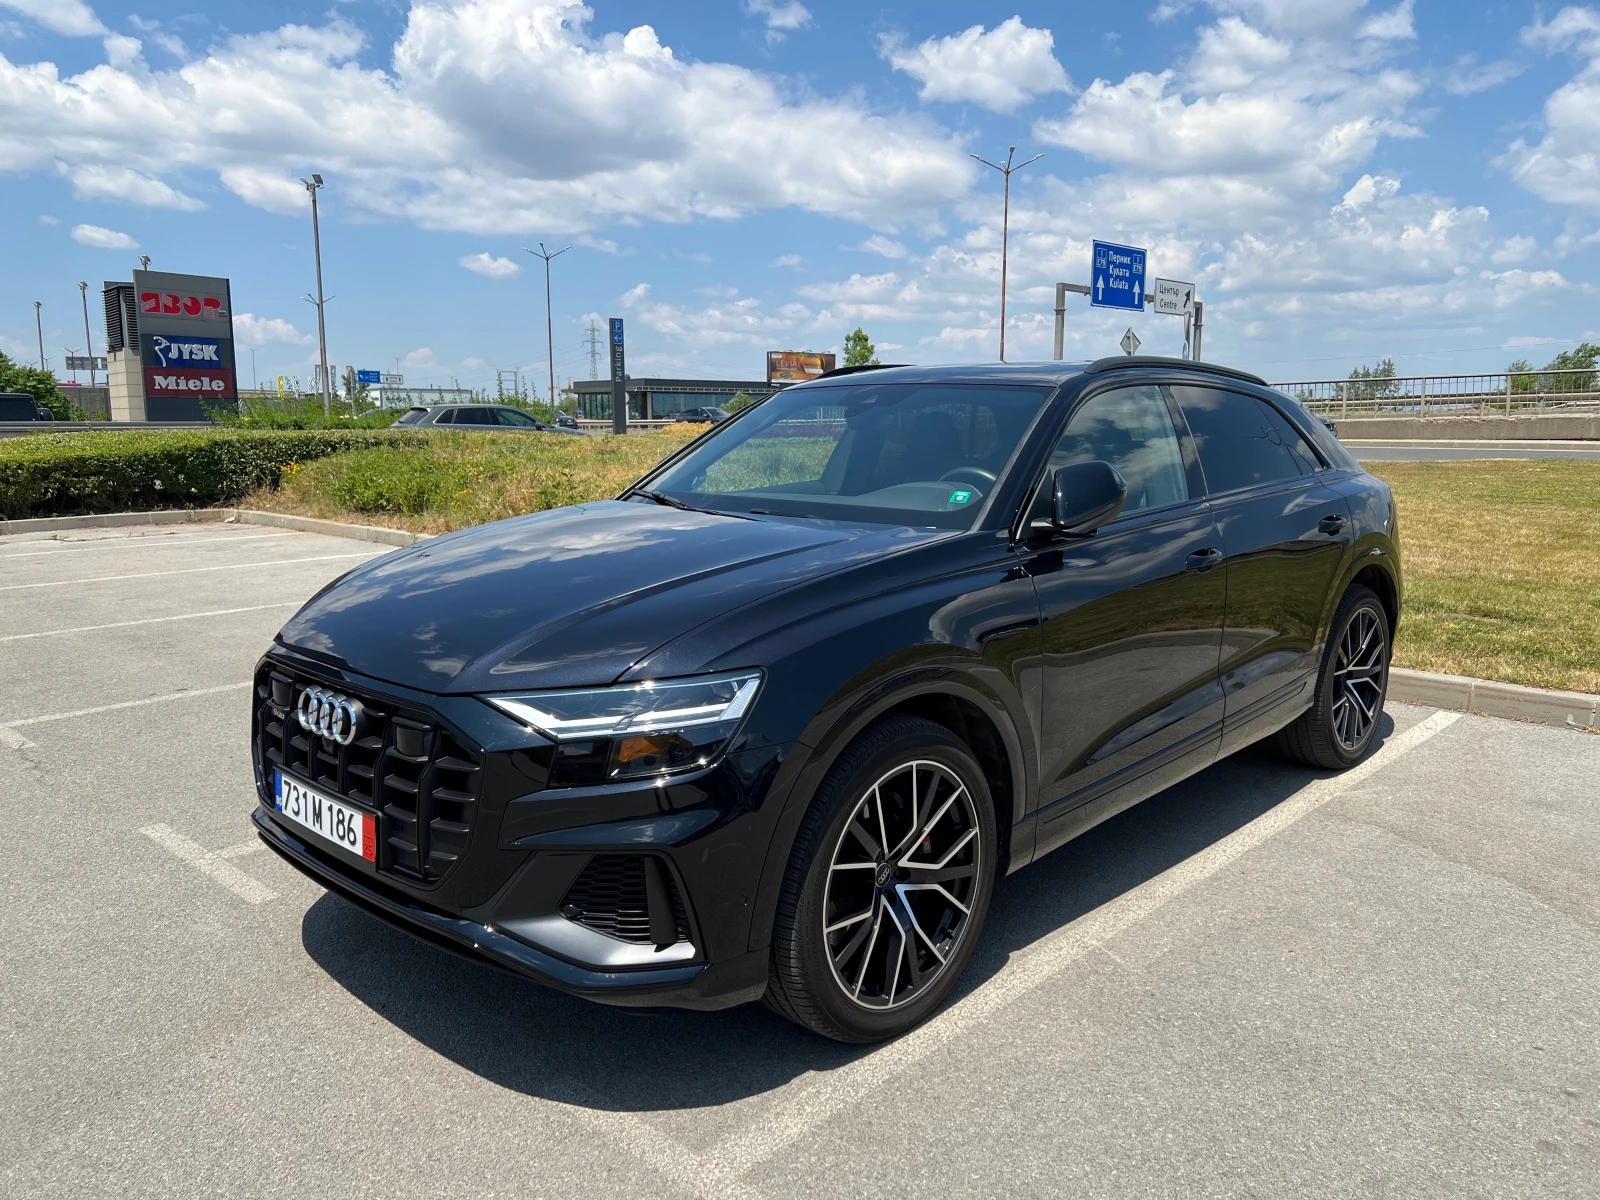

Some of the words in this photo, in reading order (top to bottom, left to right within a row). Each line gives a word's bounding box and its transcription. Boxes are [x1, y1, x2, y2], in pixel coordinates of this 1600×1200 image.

[1109, 251, 1131, 265] Перник
[1109, 264, 1129, 277] Кулата
[1109, 278, 1129, 290] Kulata
[1160, 284, 1179, 297] Център
[140, 292, 222, 318] ЯВОР
[1160, 298, 1177, 309] Centre
[168, 343, 219, 361] JYSK
[615, 345, 623, 382] Parking
[153, 375, 225, 391] Miele
